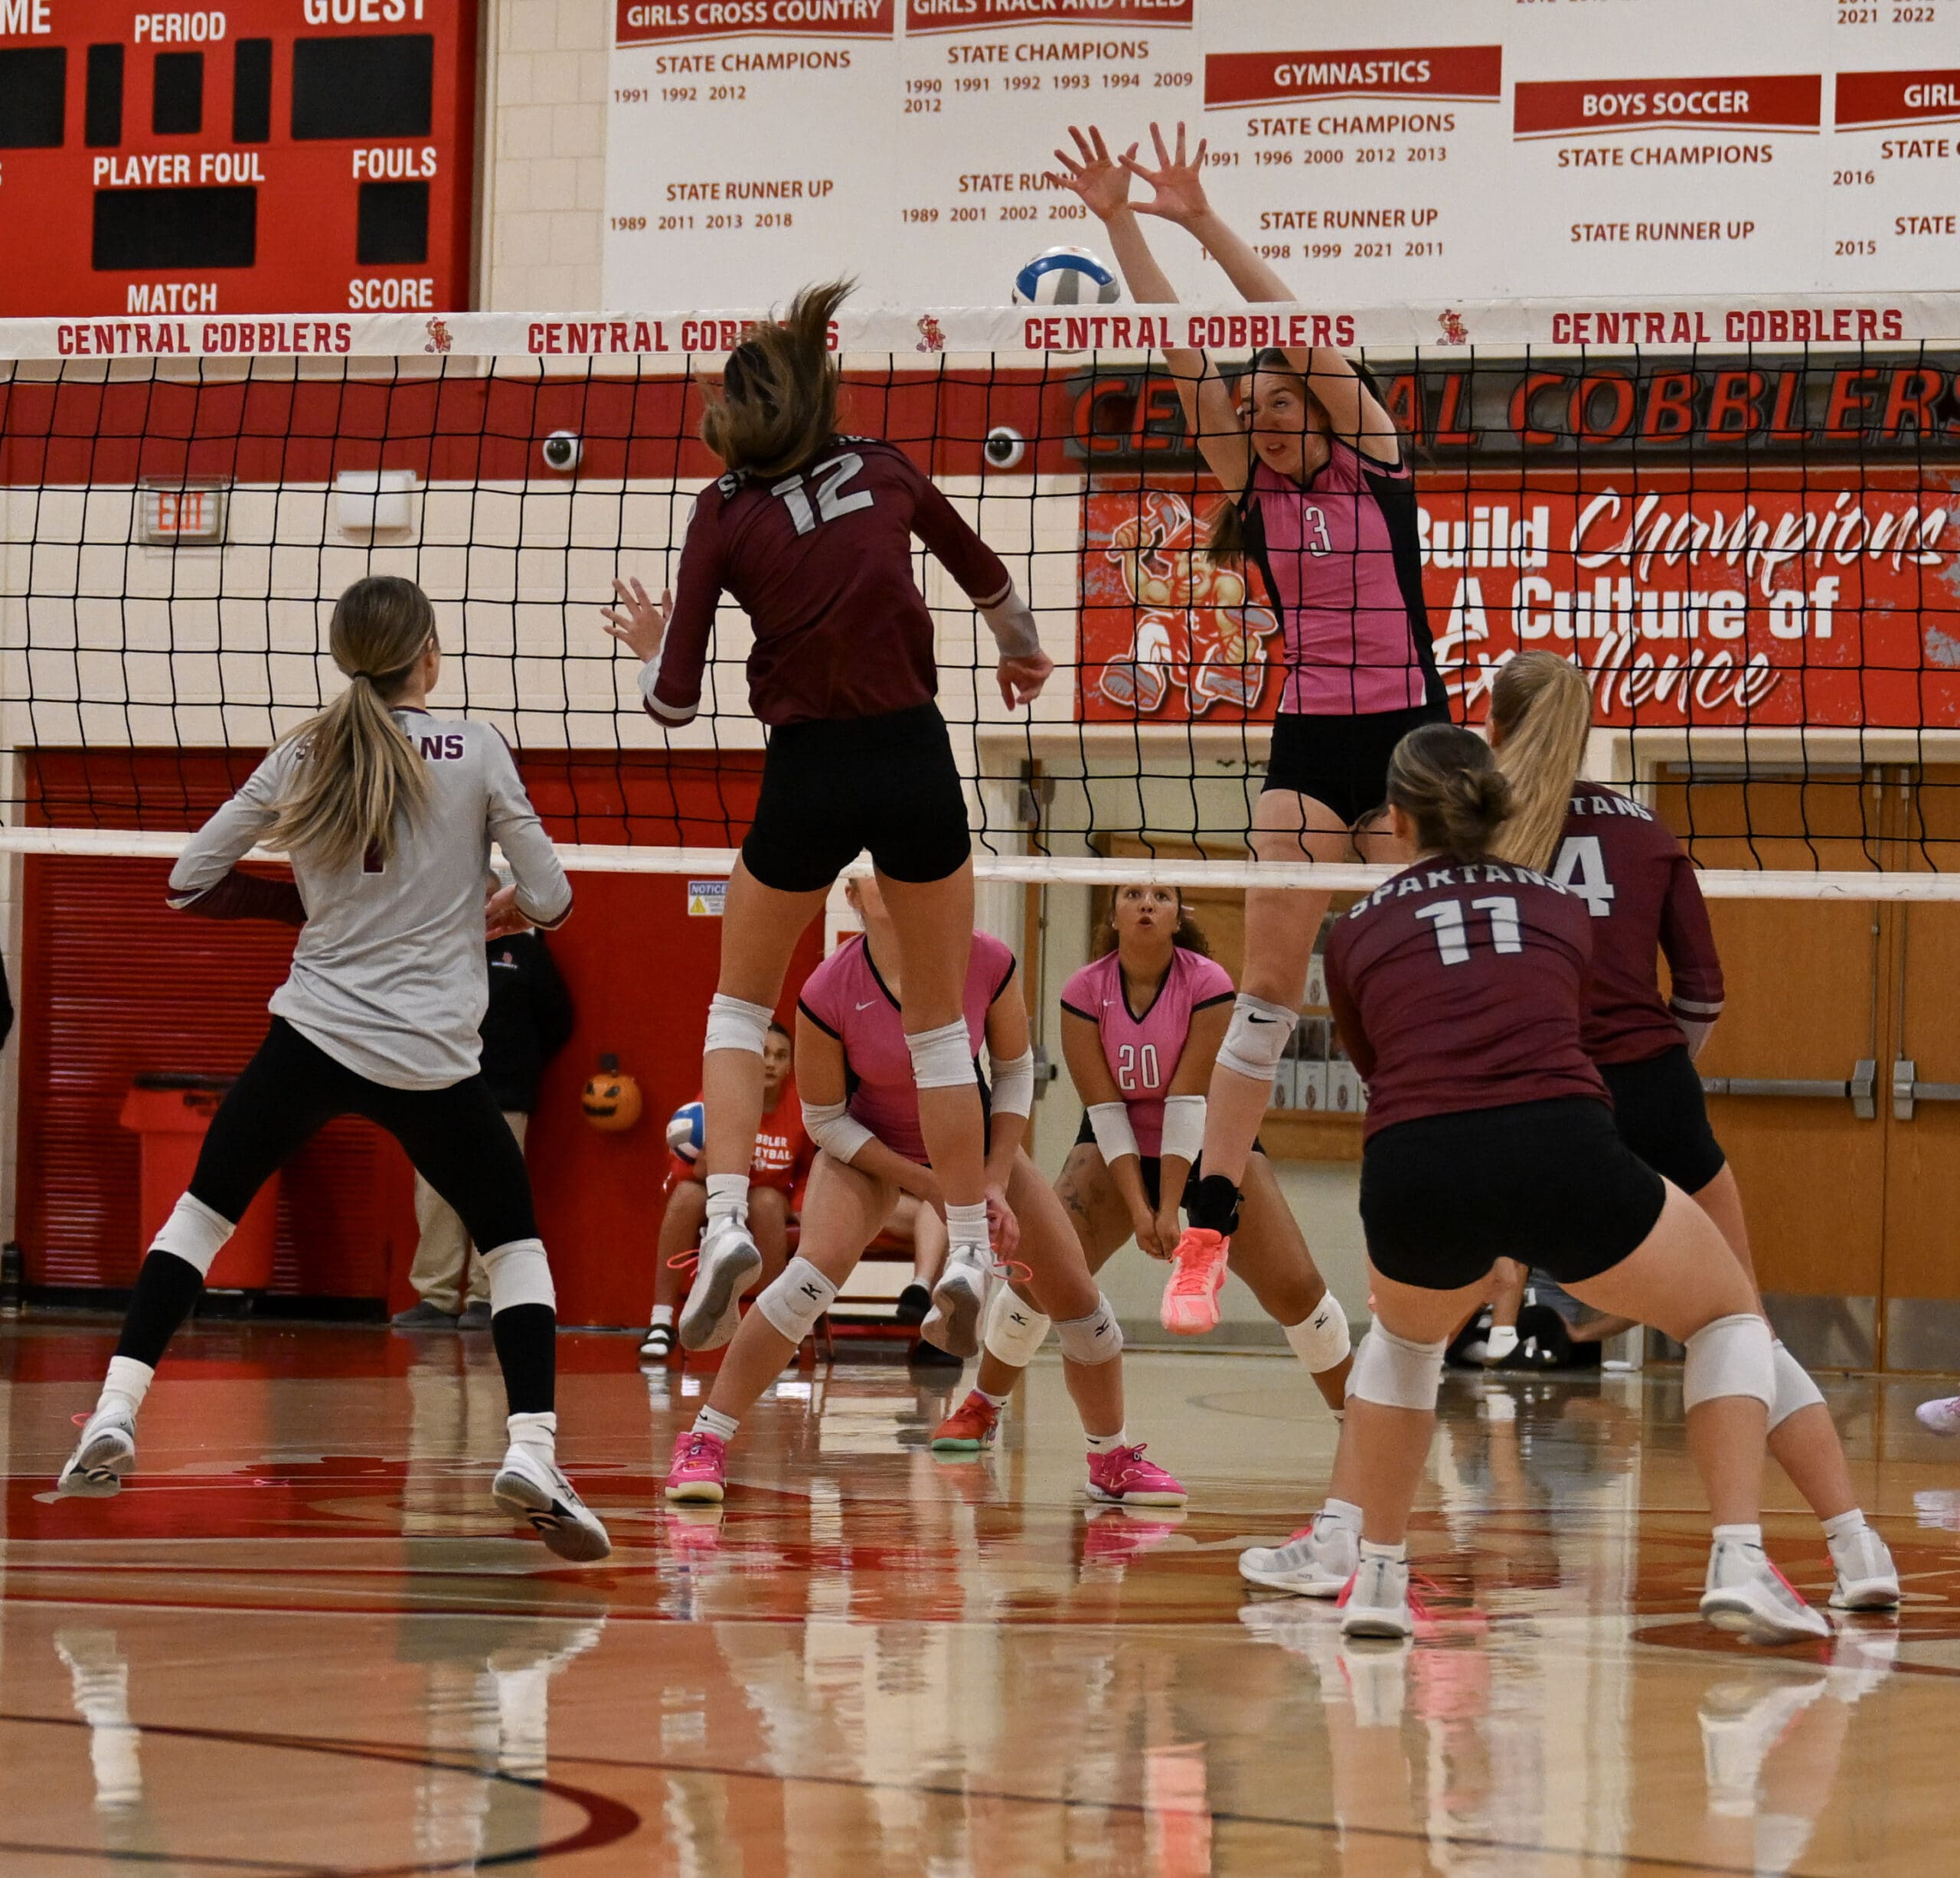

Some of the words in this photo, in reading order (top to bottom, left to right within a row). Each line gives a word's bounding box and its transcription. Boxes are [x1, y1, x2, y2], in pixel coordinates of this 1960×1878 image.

[627, 4, 689, 27] GIRLS
[694, 1, 766, 25] CROSS
[773, 0, 881, 22] COUNTRY
[1838, 8, 1877, 24] 2021
[1893, 7, 1935, 23] 2022
[135, 11, 226, 43] PERIOD
[656, 55, 715, 74] STATE
[721, 51, 851, 72] CHAMPIONS
[948, 44, 1009, 64] STATE
[1015, 41, 1149, 62] CHAMPIONS
[906, 79, 942, 93] 1990
[955, 77, 990, 92] 1991
[1004, 76, 1040, 90] 1992
[1054, 74, 1090, 90] 1993
[1102, 73, 1140, 88] 1994
[1154, 72, 1194, 87] 2009
[1274, 60, 1431, 87] GYMNASTICS
[614, 89, 648, 103] 1991
[662, 87, 697, 102] 1992
[709, 86, 746, 100] 2012
[904, 99, 942, 113] 2012
[1583, 93, 1646, 116] BOYS
[1653, 90, 1749, 115] SOCCER
[1248, 117, 1312, 137] STATE
[1318, 113, 1455, 135] CHAMPIONS
[1204, 152, 1240, 167] 1991
[1255, 151, 1292, 165] 1996
[1304, 149, 1344, 165] 2000
[1356, 149, 1396, 163] 2012
[1407, 147, 1446, 162] 2013
[1557, 148, 1624, 168] STATE
[1630, 144, 1772, 165] CHAMPIONS
[1881, 139, 1949, 159] STATE
[93, 155, 191, 185] PLAYER
[201, 152, 265, 183] FOUL
[352, 147, 436, 179] FOULS
[666, 183, 720, 201] STATE
[726, 181, 802, 200] RUNNER
[808, 179, 834, 198] UP
[959, 174, 1014, 192] STATE
[1833, 170, 1875, 186] 2016
[611, 217, 646, 230] 1989
[658, 216, 694, 230] 2011
[706, 215, 743, 229] 2013
[756, 213, 792, 227] 2018
[902, 208, 939, 223] 1989
[950, 207, 986, 222] 2001
[1000, 206, 1037, 220] 2002
[1049, 205, 1086, 220] 2003
[1260, 211, 1317, 230] STATE
[1324, 209, 1405, 228] RUNNER
[1411, 208, 1439, 227] UP
[1895, 216, 1956, 236] STATE
[1571, 223, 1629, 242] STATE
[1636, 221, 1721, 241] RUNNER
[1727, 220, 1755, 240] UP
[1303, 244, 1341, 258] 1999
[1354, 243, 1392, 257] 2021
[1405, 242, 1443, 256] 2011
[1834, 240, 1876, 256] 2015
[127, 283, 217, 313] MATCH
[349, 279, 433, 309] SCORE
[57, 322, 191, 354] CENTRAL
[203, 322, 351, 353] COBBLERS
[528, 320, 668, 354] CENTRAL
[1025, 316, 1174, 349] CENTRAL
[1189, 315, 1355, 348] COBBLERS
[1553, 312, 1711, 344] CENTRAL
[1726, 309, 1902, 341] COBBLERS
[770, 452, 874, 536] 12
[158, 492, 205, 531] EXIT
[1305, 506, 1331, 557] 3
[1570, 488, 1947, 598] Champions
[1446, 577, 1489, 638] A
[1511, 576, 1746, 639] Culture
[1769, 576, 1839, 639] of
[1570, 796, 1653, 821] TANS
[1552, 836, 1615, 916] 4
[691, 884, 727, 895] NOTICE
[1349, 864, 1567, 919] SPARTANS
[1415, 897, 1523, 965] 11
[1118, 1044, 1161, 1090] 20
